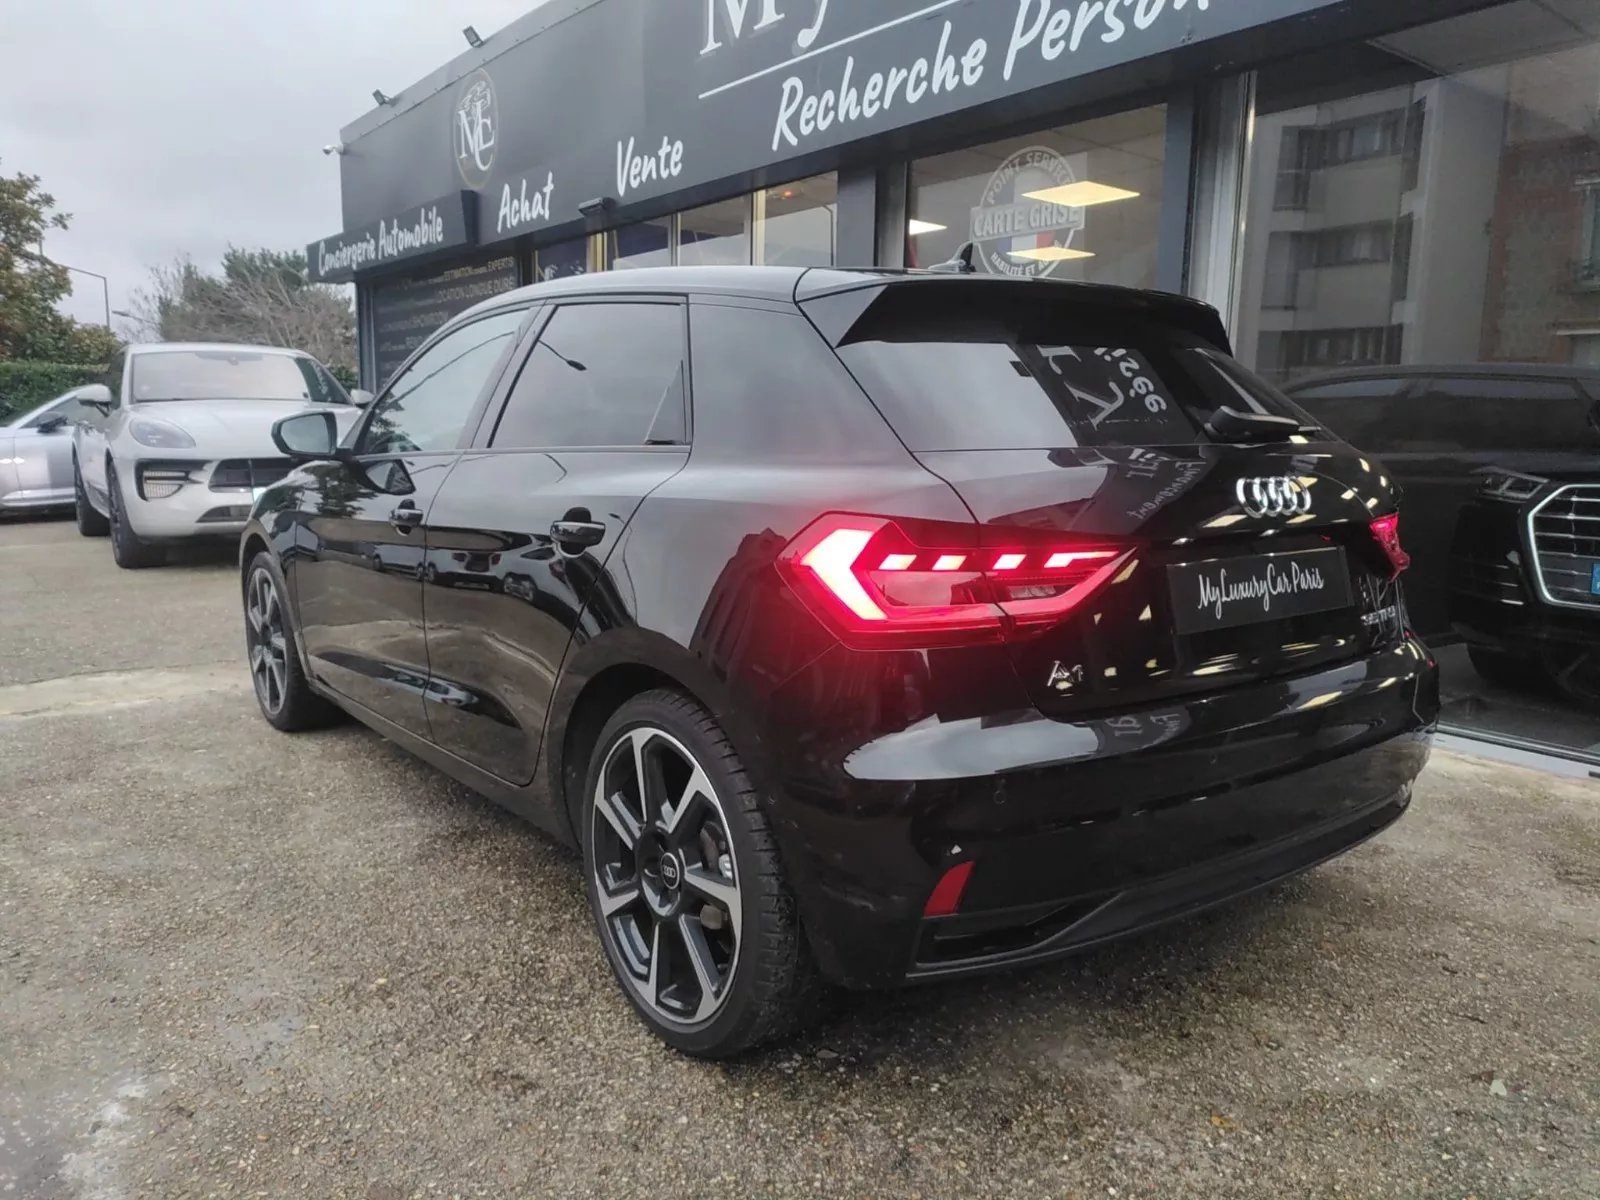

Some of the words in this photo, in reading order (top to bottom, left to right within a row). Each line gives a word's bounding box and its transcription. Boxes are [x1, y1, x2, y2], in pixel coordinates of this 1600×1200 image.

[772, 21, 988, 152] Recherche
[1002, 0, 1209, 81] Perso
[616, 136, 684, 197] Vente
[986, 157, 1021, 204] POINT
[497, 172, 554, 233] Achat
[973, 208, 1025, 237] CARTE
[1030, 202, 1080, 228] GRISE
[318, 232, 376, 277] Conciergerie
[379, 205, 444, 260] Automobile
